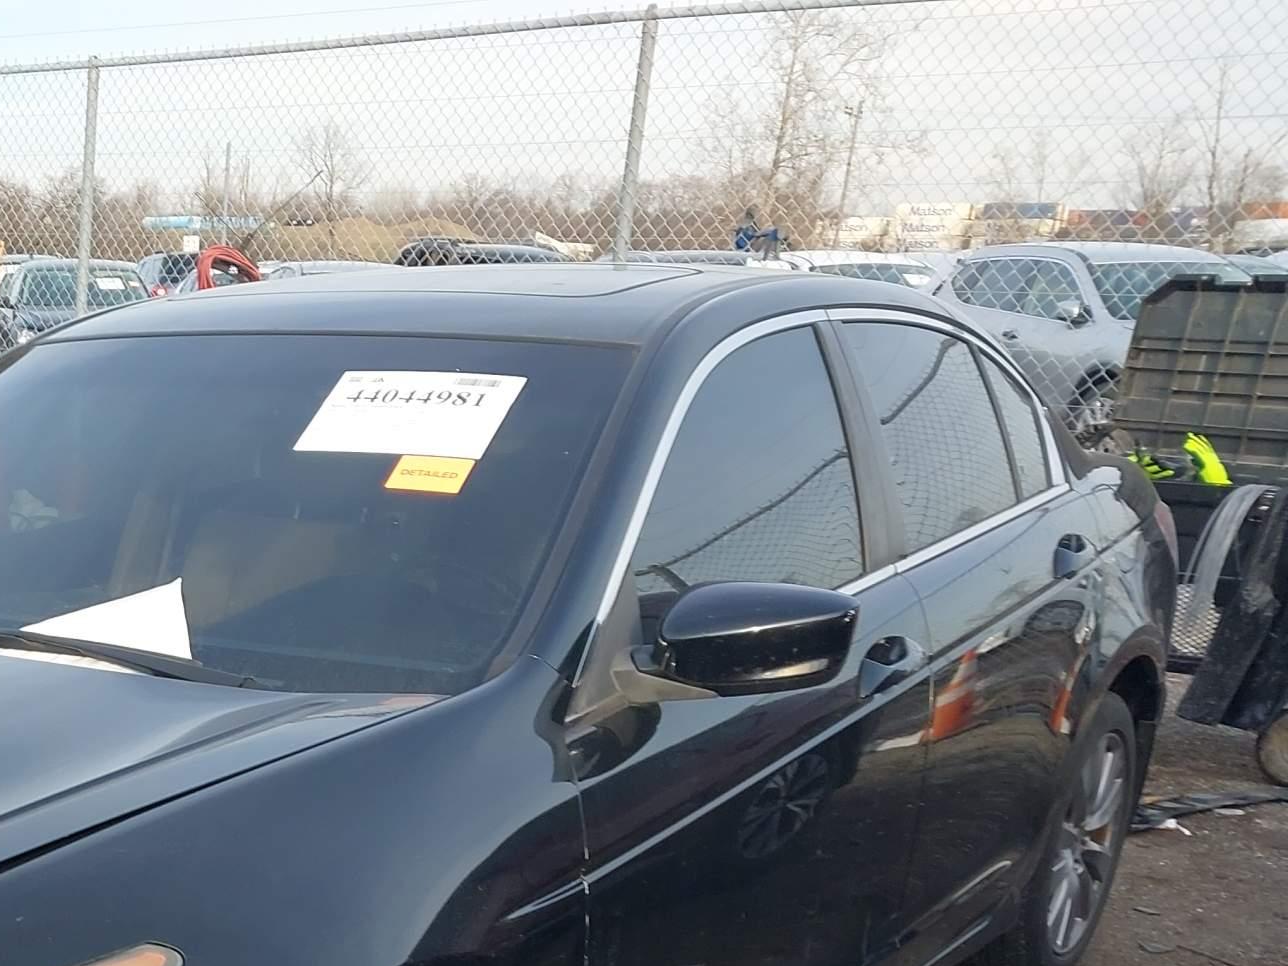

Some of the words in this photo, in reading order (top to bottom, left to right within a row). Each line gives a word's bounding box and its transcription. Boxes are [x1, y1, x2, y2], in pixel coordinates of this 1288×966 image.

[909, 205, 953, 217] Matson
[345, 388, 487, 408] 44044981
[399, 468, 459, 479] DETAILED
